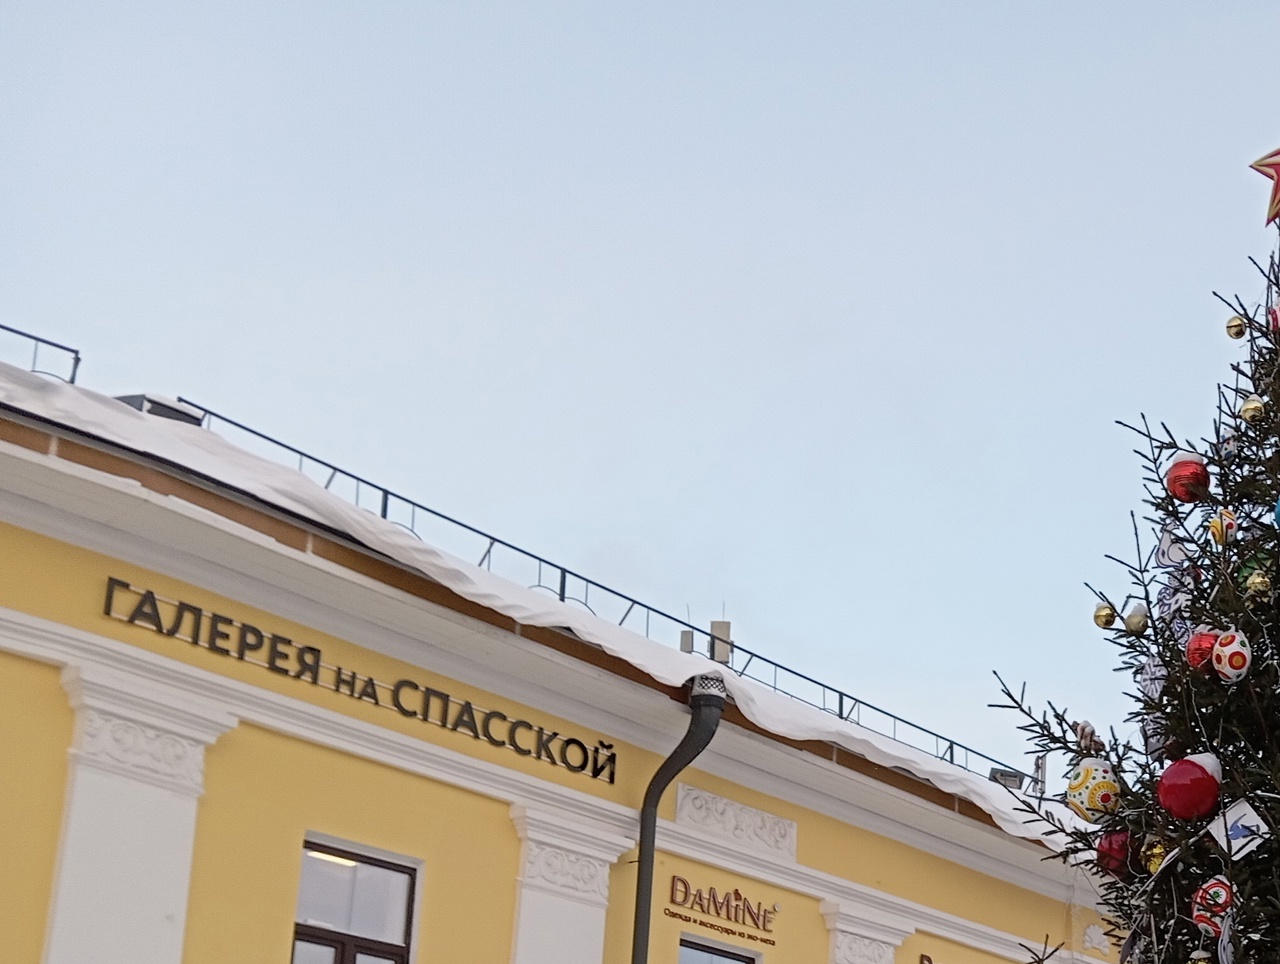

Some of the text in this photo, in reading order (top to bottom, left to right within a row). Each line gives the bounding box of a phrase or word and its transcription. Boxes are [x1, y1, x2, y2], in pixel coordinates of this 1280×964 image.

[104, 577, 617, 784] ГАЛЕРЕЯ НА СПАССКОЙ
[663, 908, 691, 922] Одежда
